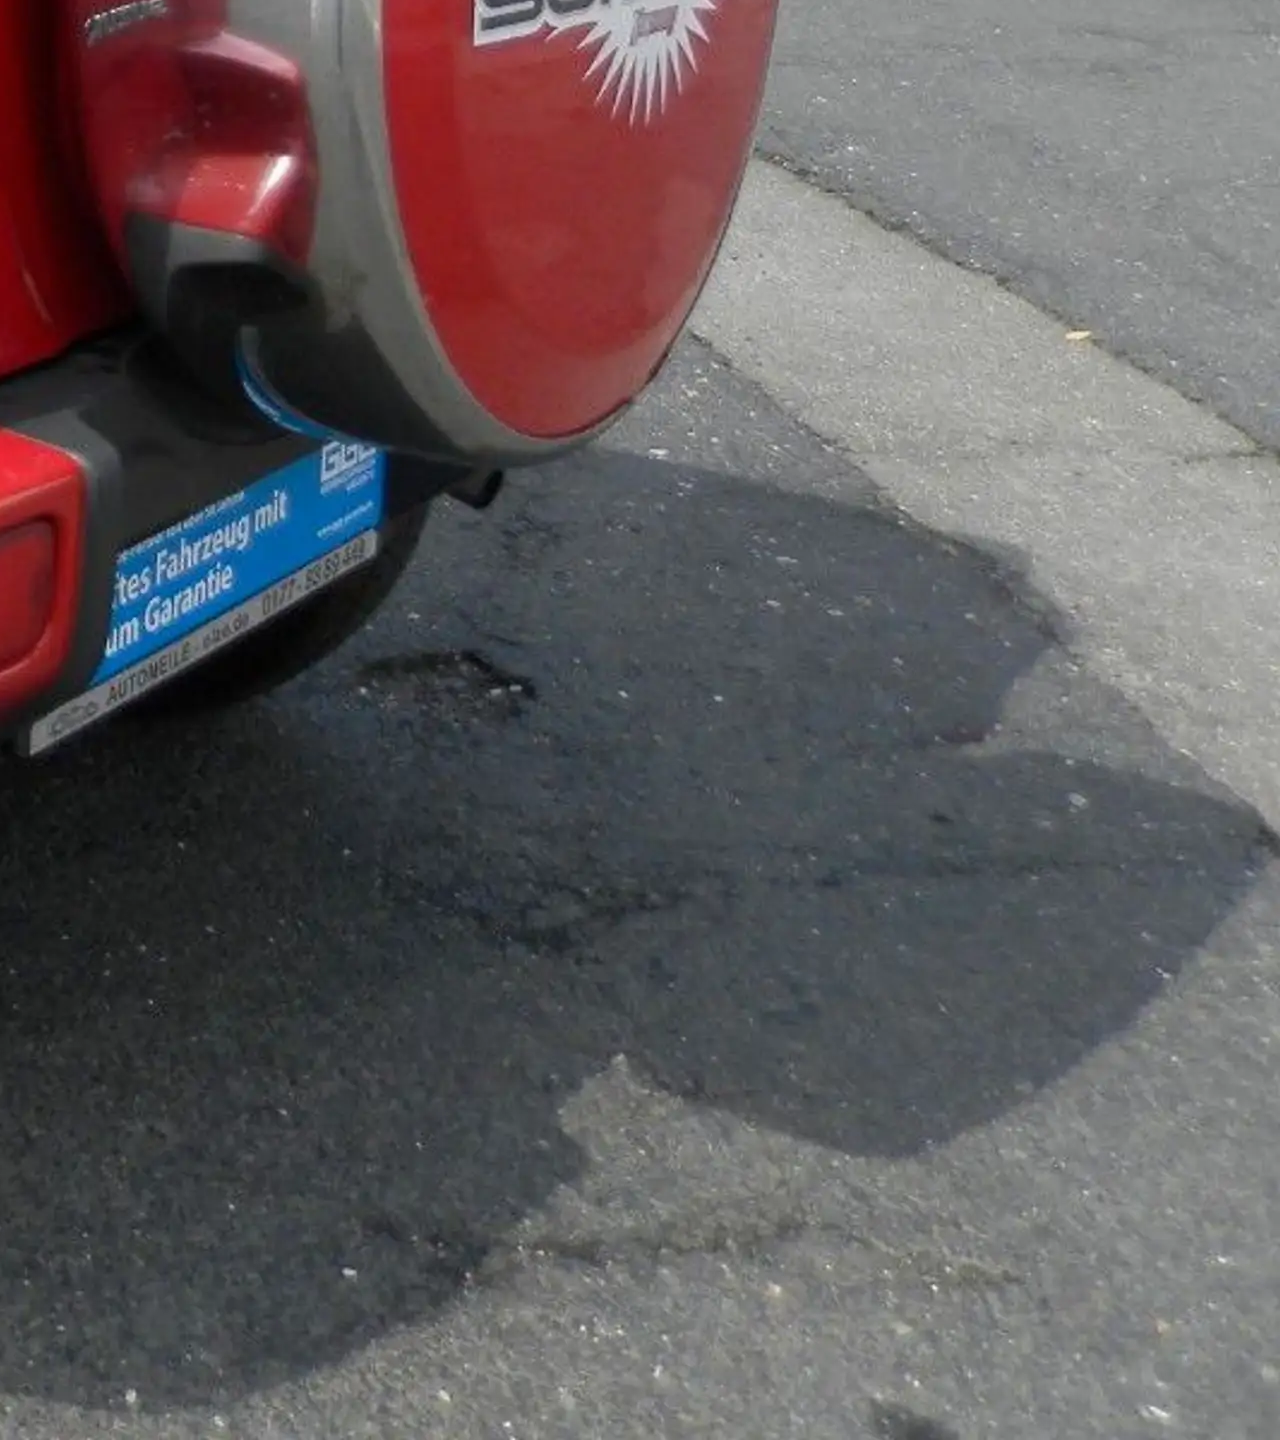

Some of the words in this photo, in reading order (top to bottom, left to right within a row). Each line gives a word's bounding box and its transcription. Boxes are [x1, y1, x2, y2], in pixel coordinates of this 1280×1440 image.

[113, 565, 151, 609] tes
[155, 514, 251, 586] Fahrzeug
[253, 490, 288, 534] mit
[144, 561, 234, 633] Garantie
